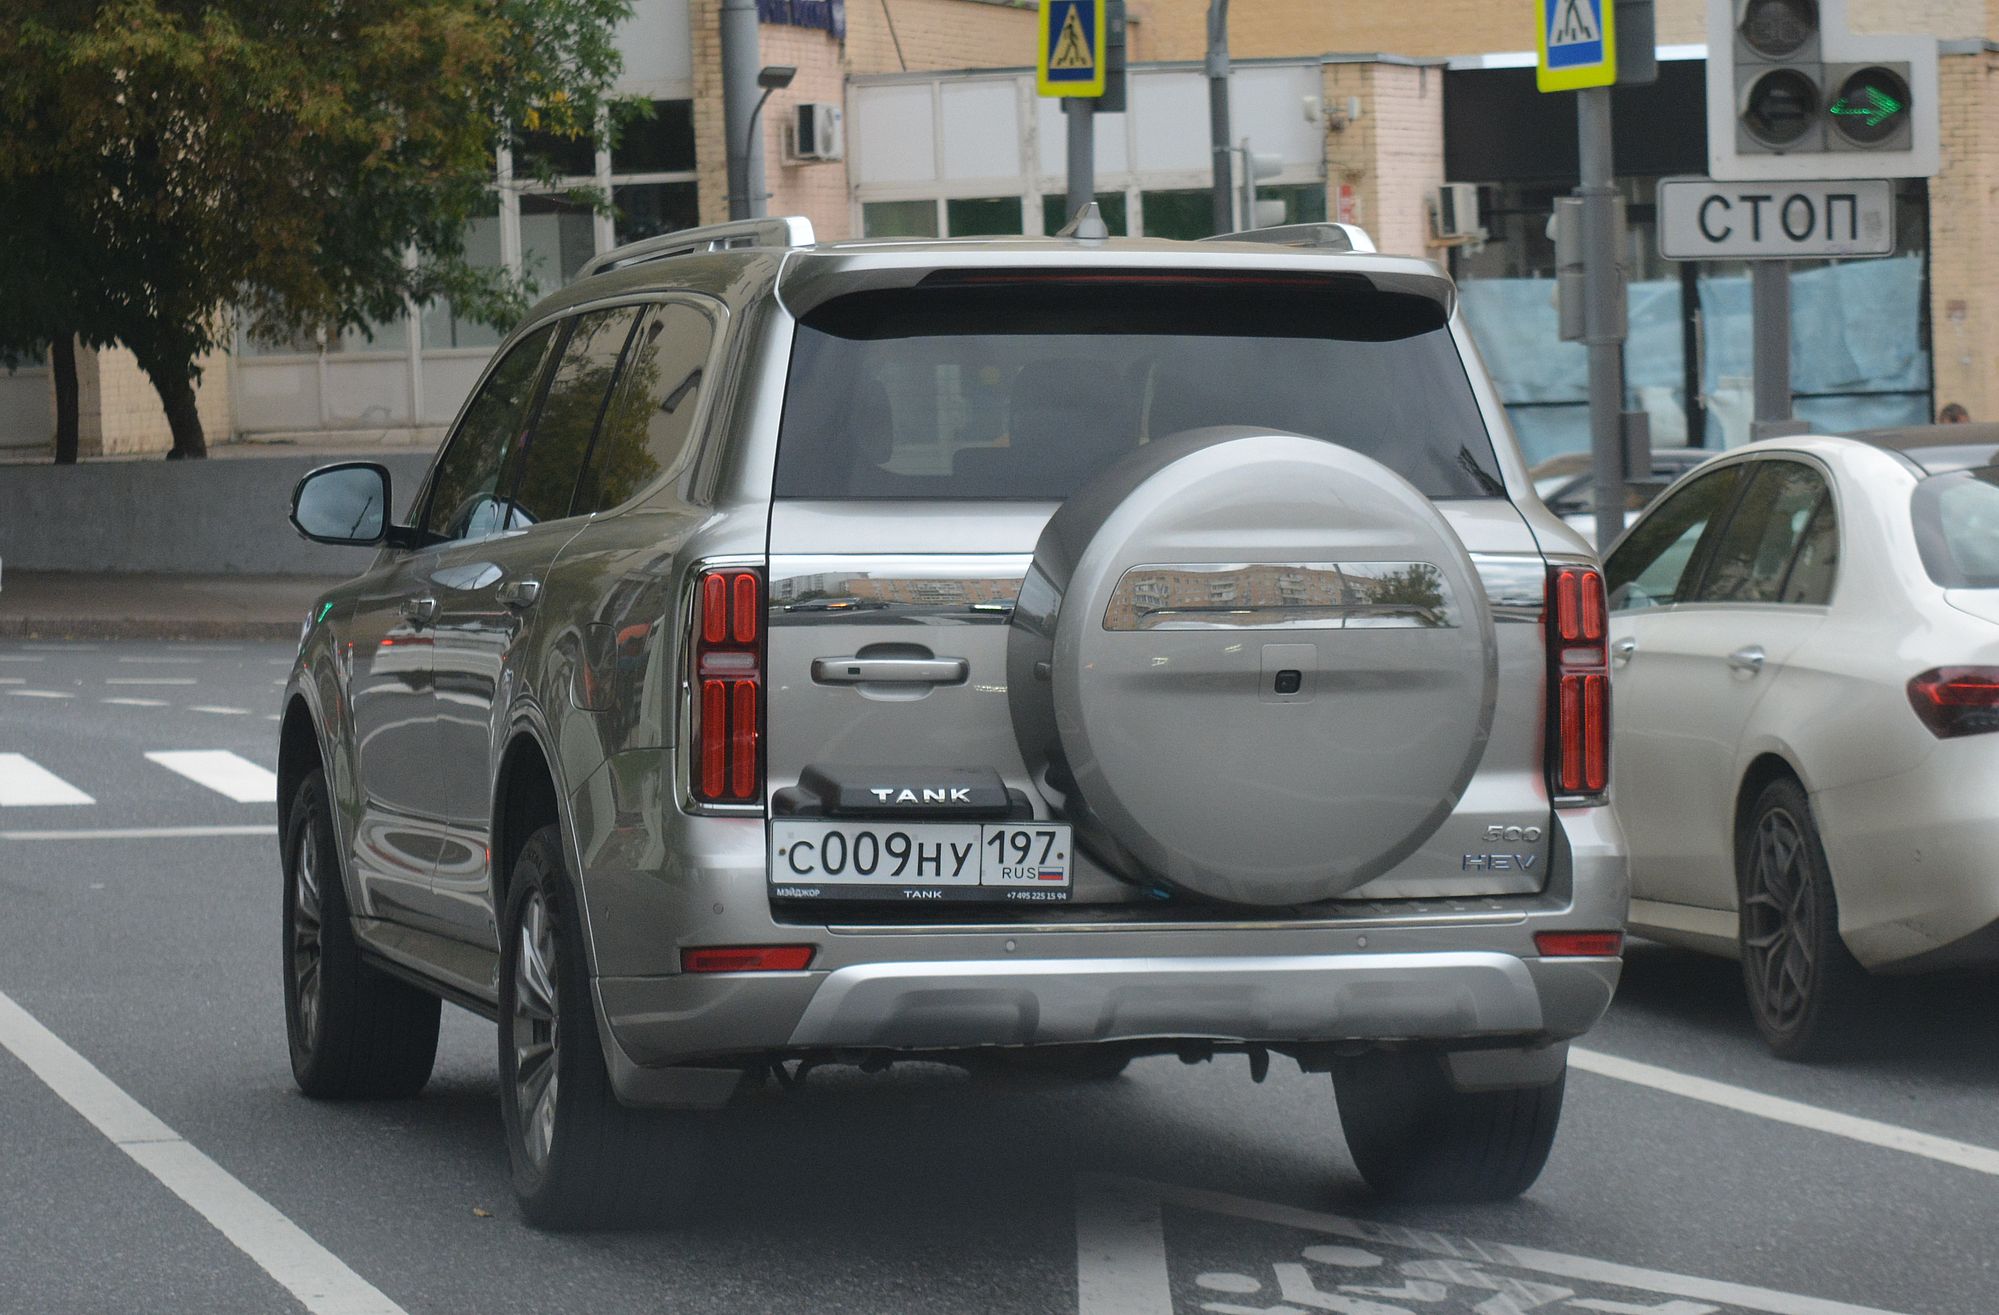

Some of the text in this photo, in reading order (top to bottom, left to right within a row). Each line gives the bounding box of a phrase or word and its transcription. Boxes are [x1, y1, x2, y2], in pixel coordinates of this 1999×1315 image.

[1698, 194, 1858, 243] СТОП
[871, 787, 972, 804] TANK
[1482, 825, 1542, 842] 500
[987, 830, 1057, 866] 197
[1461, 853, 1536, 872] HEV
[1002, 867, 1037, 880] RUS
[776, 887, 821, 898] МЭЙДЖОР
[903, 890, 943, 899] TANK
[1007, 892, 1016, 900] +7
[1017, 892, 1031, 900] 495
[1032, 892, 1046, 900] 225
[1057, 892, 1067, 900] 94
